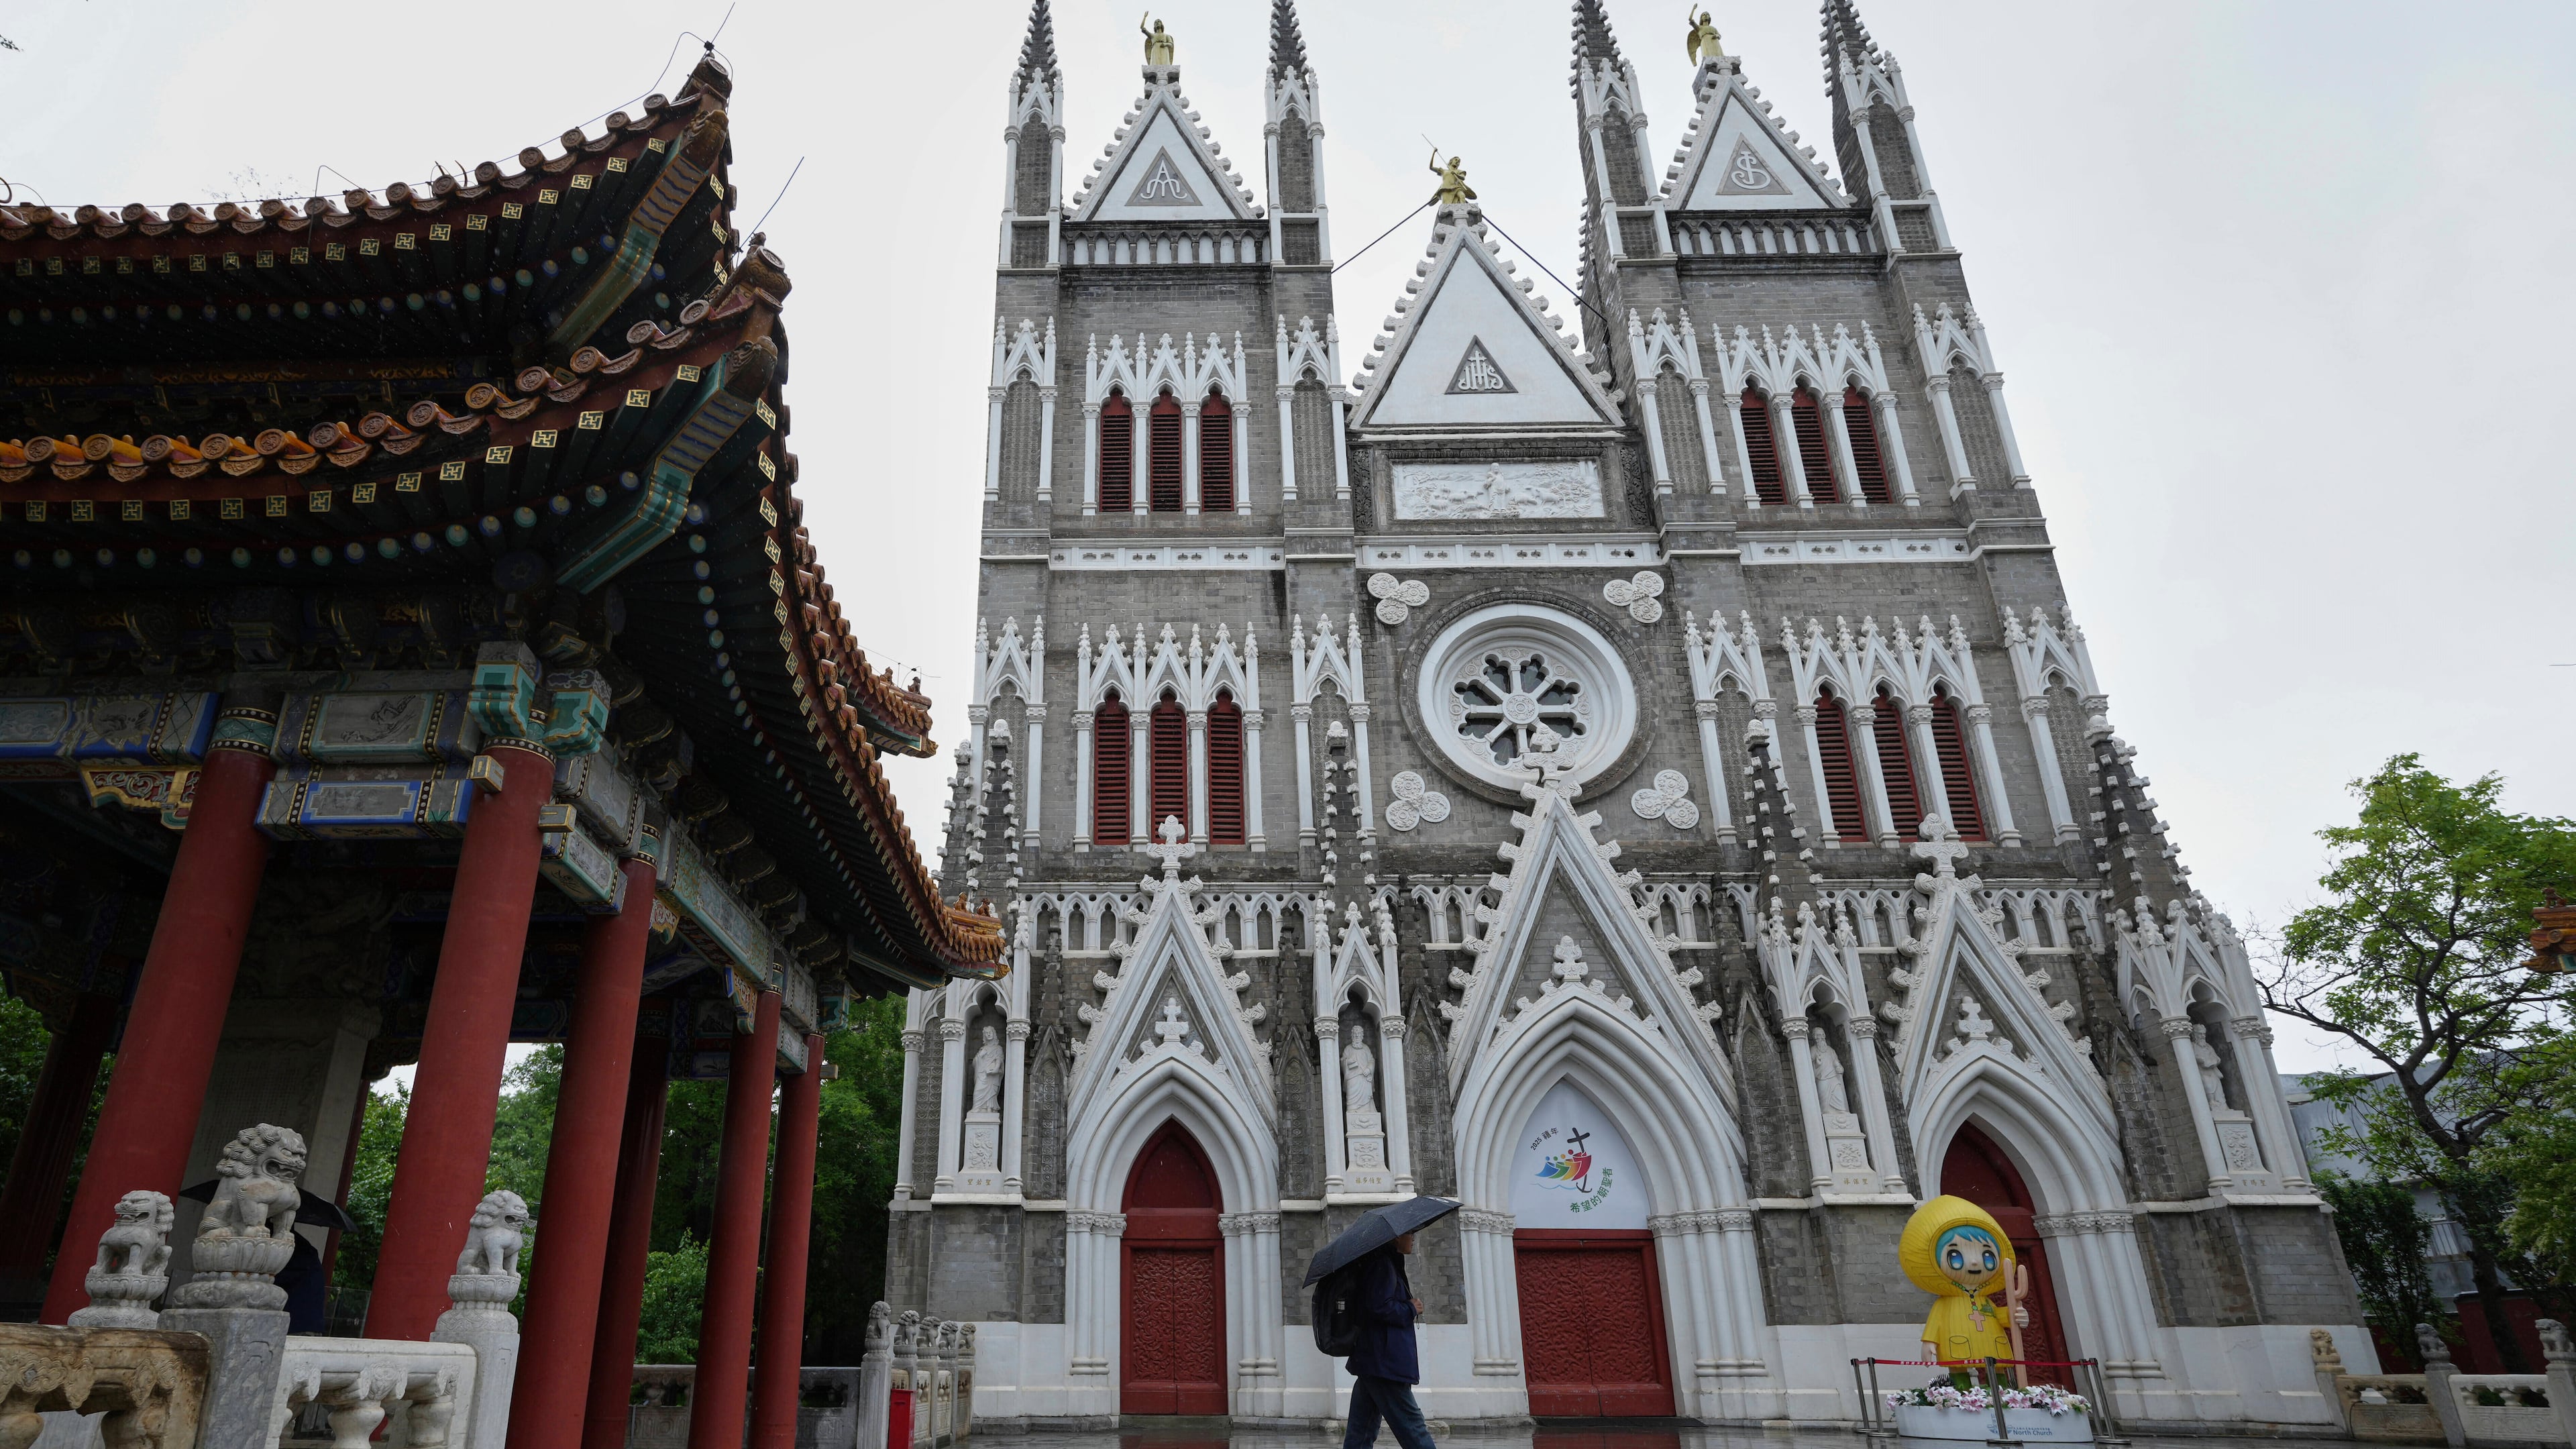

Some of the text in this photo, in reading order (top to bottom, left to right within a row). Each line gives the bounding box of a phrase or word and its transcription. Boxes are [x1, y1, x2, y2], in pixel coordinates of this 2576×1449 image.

[1530, 1127, 1559, 1150] 2025 禧年
[1570, 1167, 1613, 1214] 希望的朝聖者
